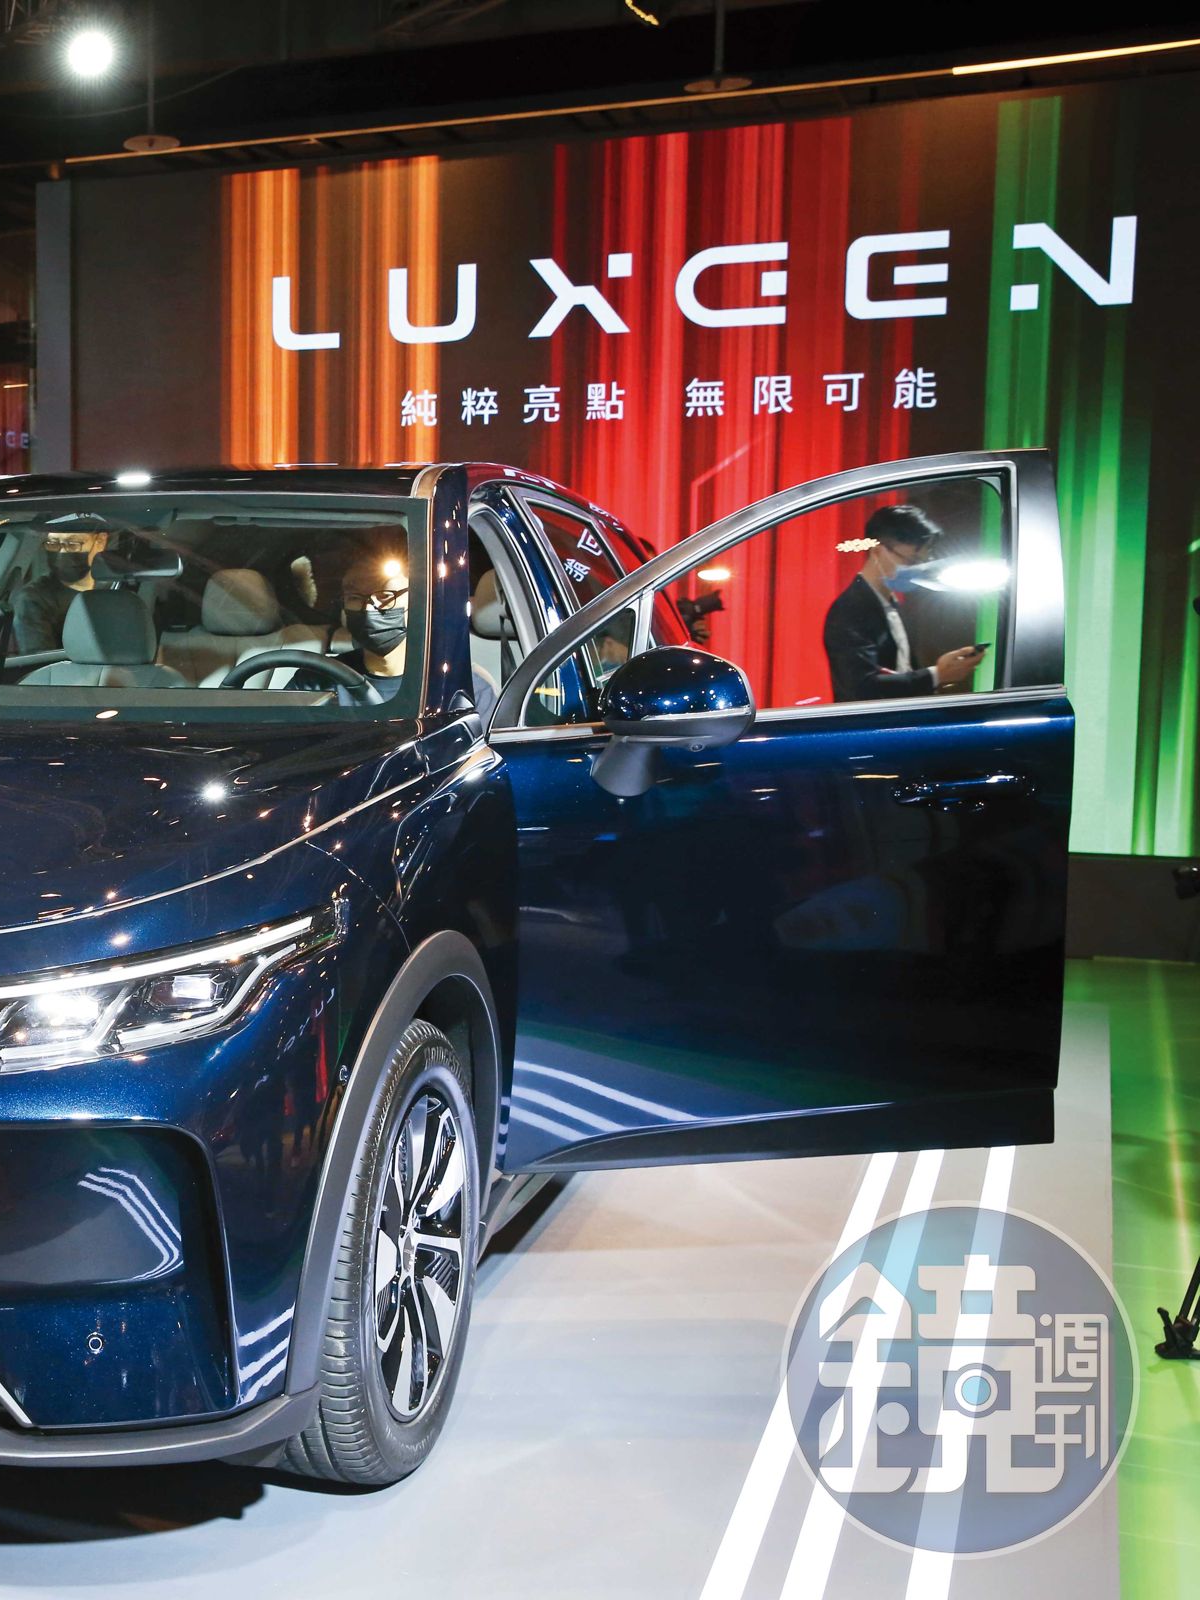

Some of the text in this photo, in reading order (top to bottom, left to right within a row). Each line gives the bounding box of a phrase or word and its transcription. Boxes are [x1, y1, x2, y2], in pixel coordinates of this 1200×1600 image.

[272, 216, 1137, 350] LUXGEN
[400, 367, 937, 427] 純粹亮點 無限可能
